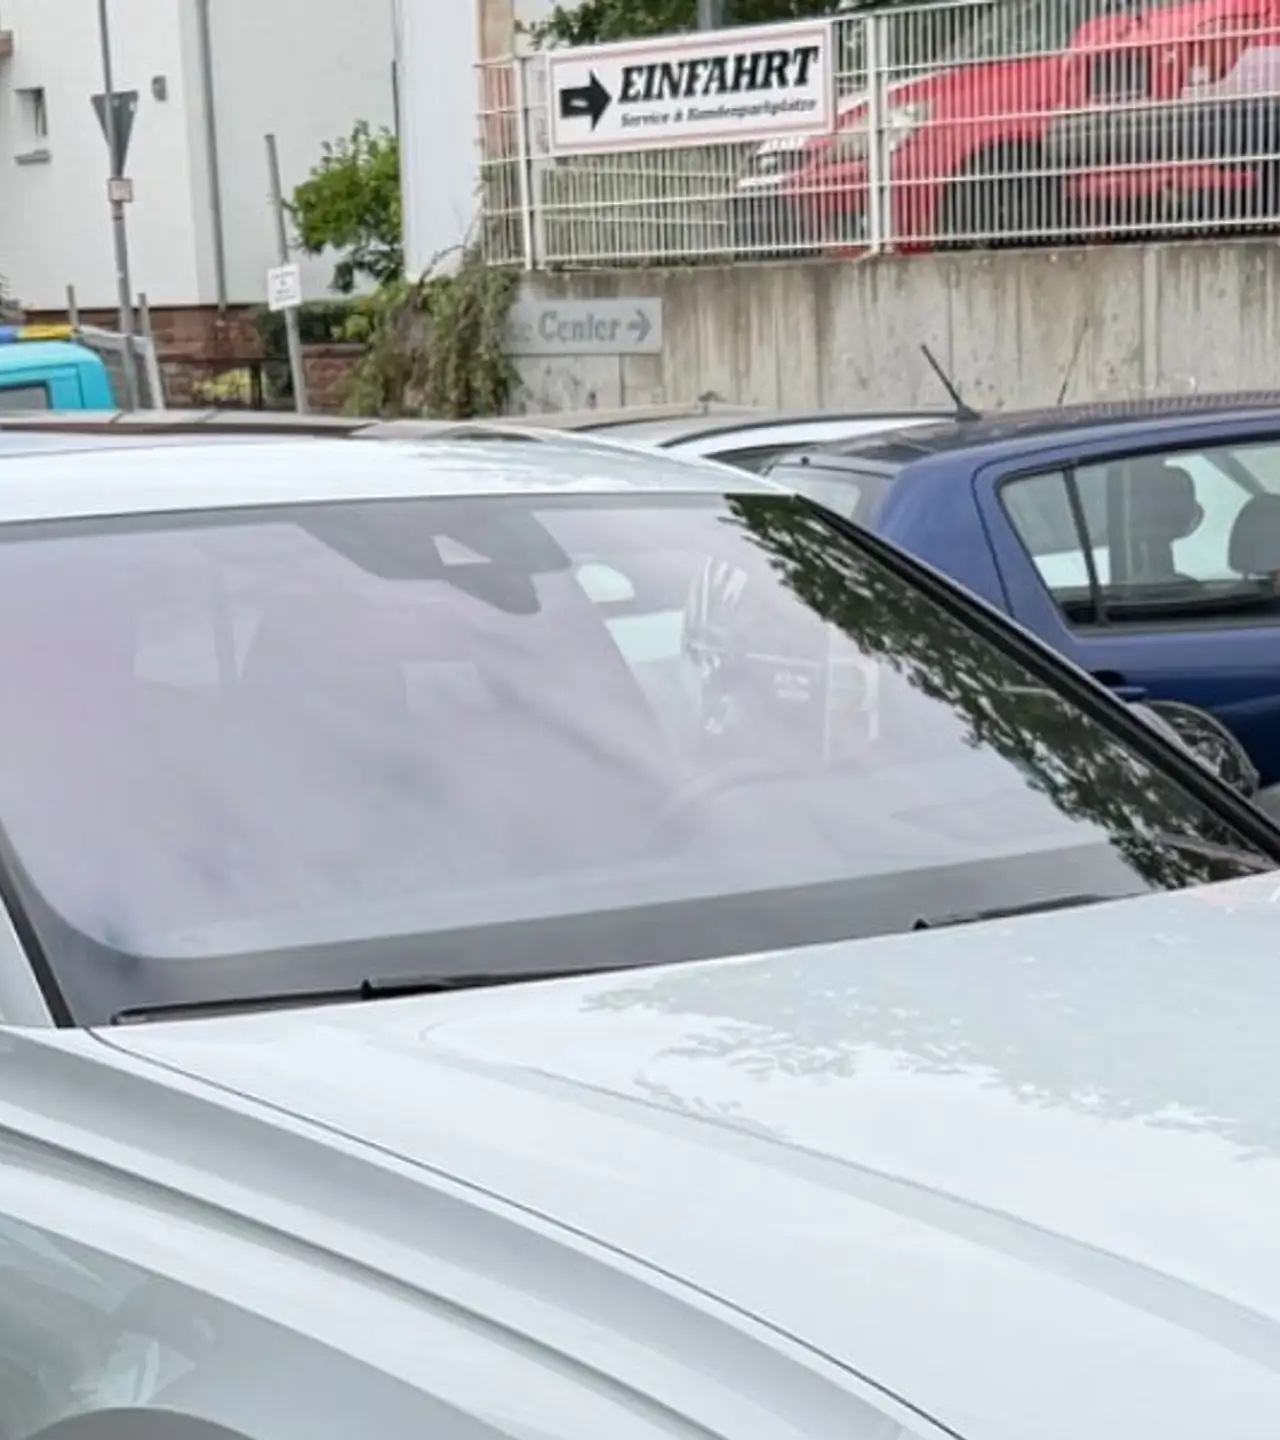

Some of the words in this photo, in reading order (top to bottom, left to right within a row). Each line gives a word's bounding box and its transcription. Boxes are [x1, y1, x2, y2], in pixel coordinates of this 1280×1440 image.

[618, 45, 819, 104] EINFAHRT
[621, 112, 669, 128] Service
[538, 310, 621, 342] Center
